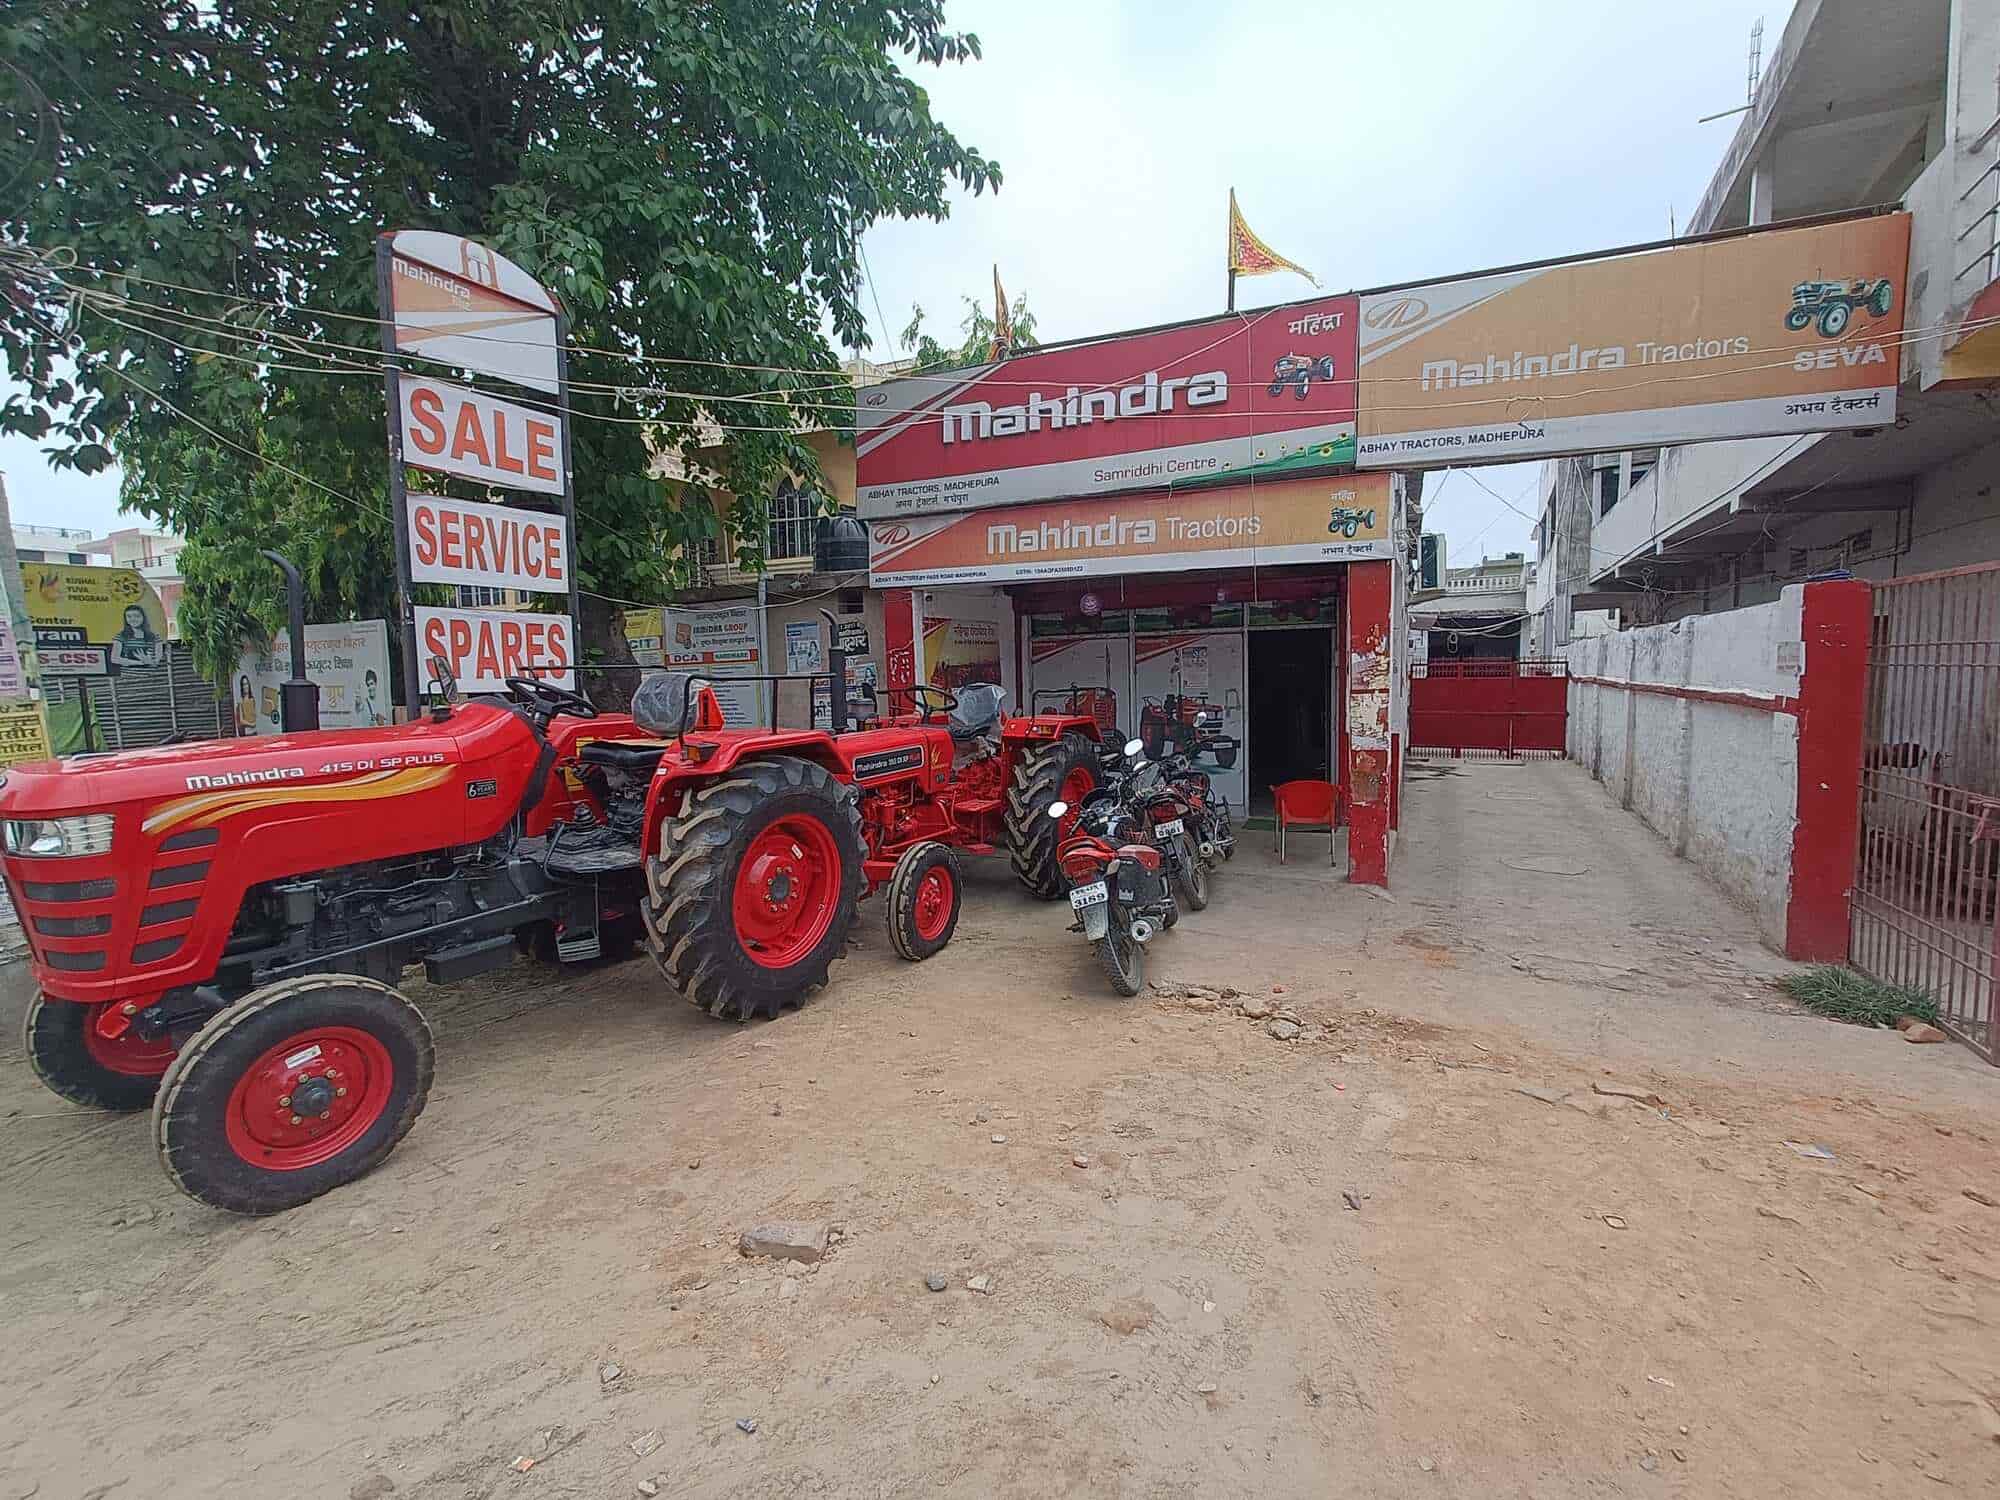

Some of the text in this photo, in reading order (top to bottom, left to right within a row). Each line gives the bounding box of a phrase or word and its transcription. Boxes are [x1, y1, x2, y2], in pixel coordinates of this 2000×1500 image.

[1422, 335, 1750, 392] Mahindra Tractors
[1793, 343, 1886, 371] SEVA
[943, 370, 1228, 444] Mahindra
[1784, 402, 1826, 415] अभय
[409, 388, 557, 481] SALE
[1360, 429, 1545, 454] ABHAY TRACTORS, MADHEPURA
[868, 489, 894, 499] ABHAY
[943, 476, 999, 491] MADHEPURA
[1094, 457, 1217, 482] Samriddhi Centre
[414, 506, 562, 580] SERVICE
[987, 513, 1261, 555] Mahindra Tractors
[424, 618, 567, 680] SPARES
[186, 753, 444, 790] Mahindra 415 DI SP PLUS
[469, 784, 477, 797] 6
